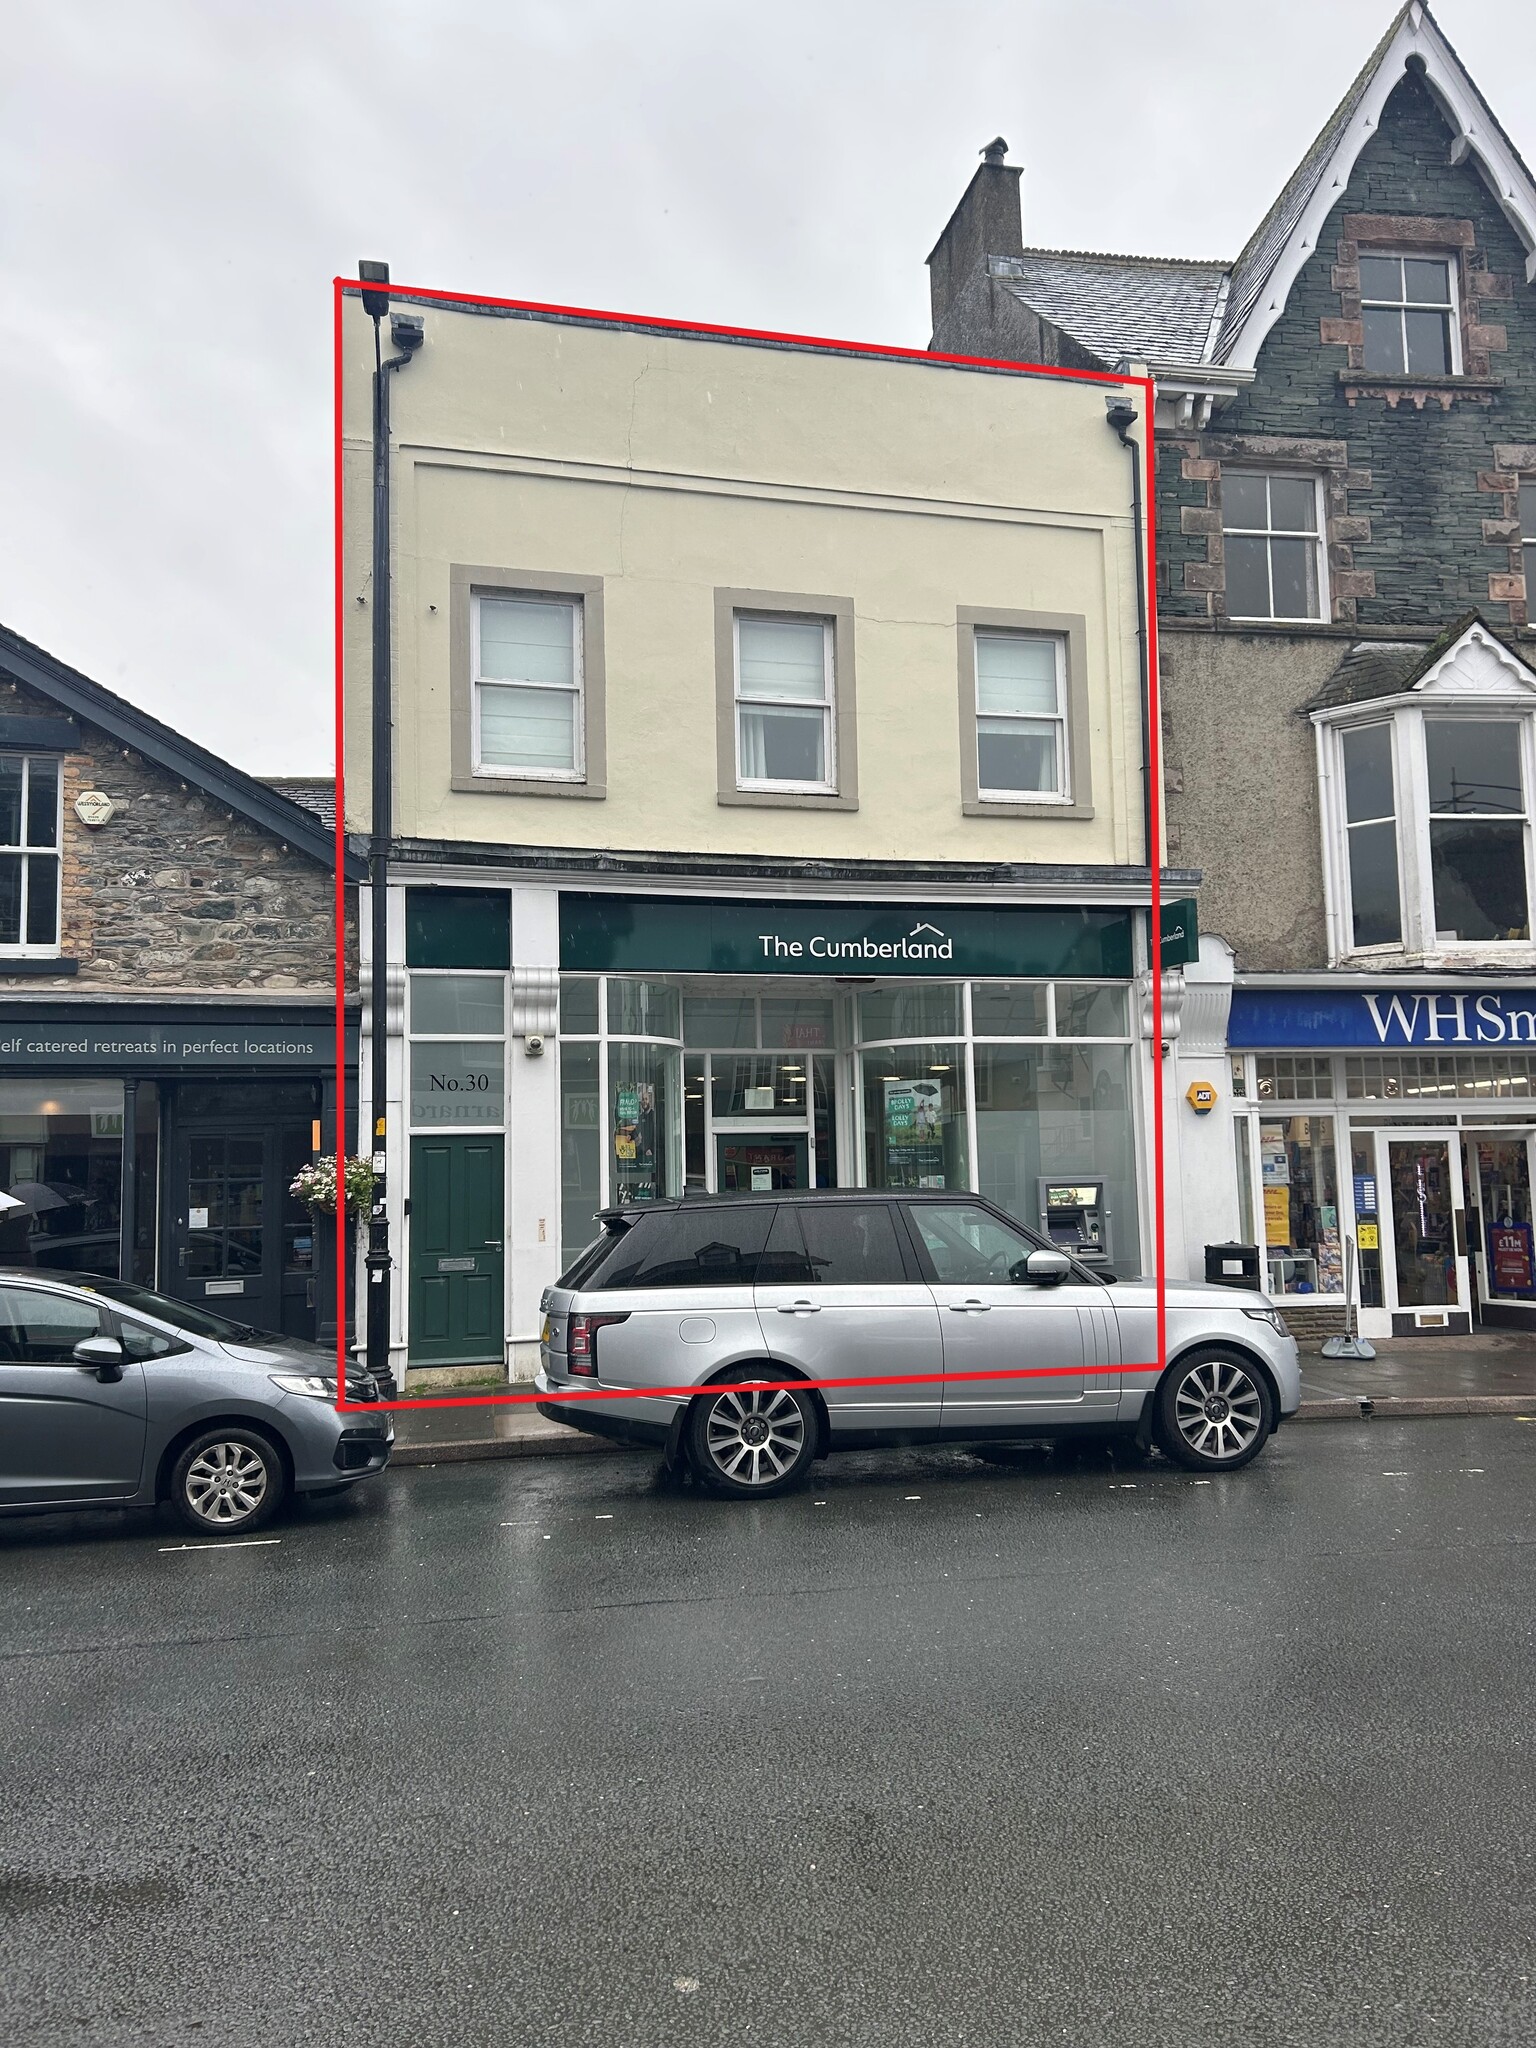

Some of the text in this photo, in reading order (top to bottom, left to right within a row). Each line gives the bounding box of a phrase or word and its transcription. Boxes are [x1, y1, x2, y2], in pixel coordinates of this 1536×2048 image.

[1160, 930, 1184, 944] umberland
[758, 935, 953, 959] The Cumberland
[0, 1038, 313, 1057] elf catered retreats in perfect locations
[429, 1073, 489, 1092] No.30
[1197, 1091, 1211, 1100] ADT
